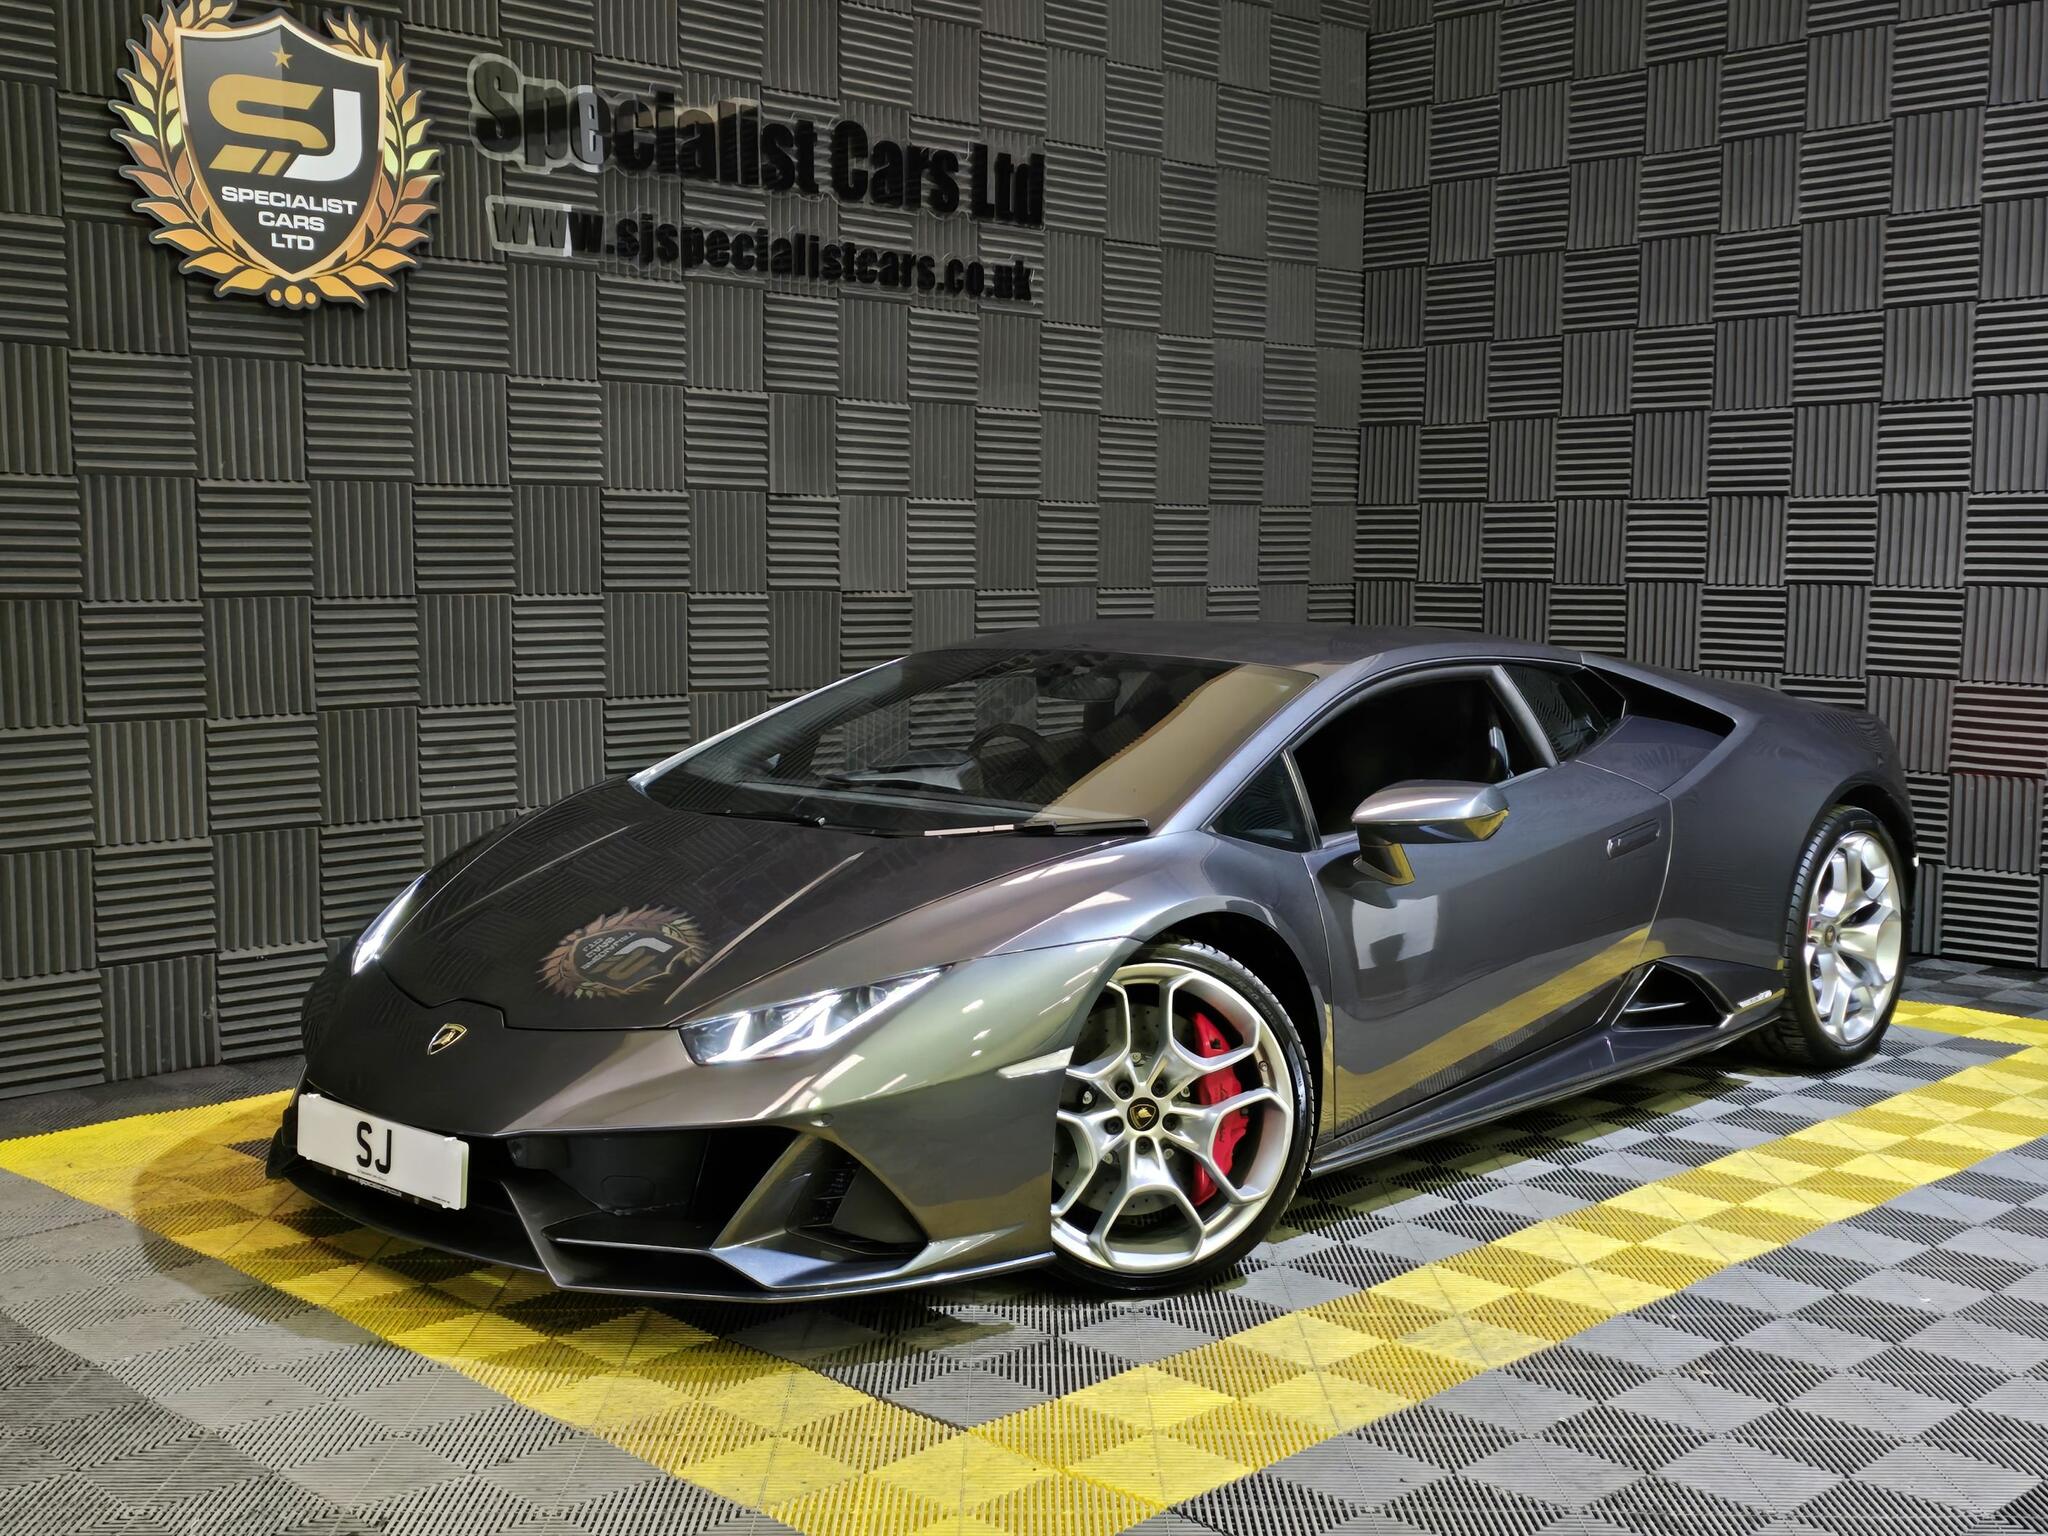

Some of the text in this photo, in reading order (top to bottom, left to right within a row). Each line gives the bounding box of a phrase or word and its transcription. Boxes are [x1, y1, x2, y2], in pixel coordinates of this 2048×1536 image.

[208, 73, 363, 182] SJ
[473, 61, 1045, 225] Specialist Cars Ltd
[221, 186, 358, 215] SPECIALIST
[258, 210, 325, 232] CARS
[271, 233, 314, 250] LTD
[492, 202, 1032, 300] www.sjspecialistcars.co.uk
[356, 1121, 392, 1175] SJ
